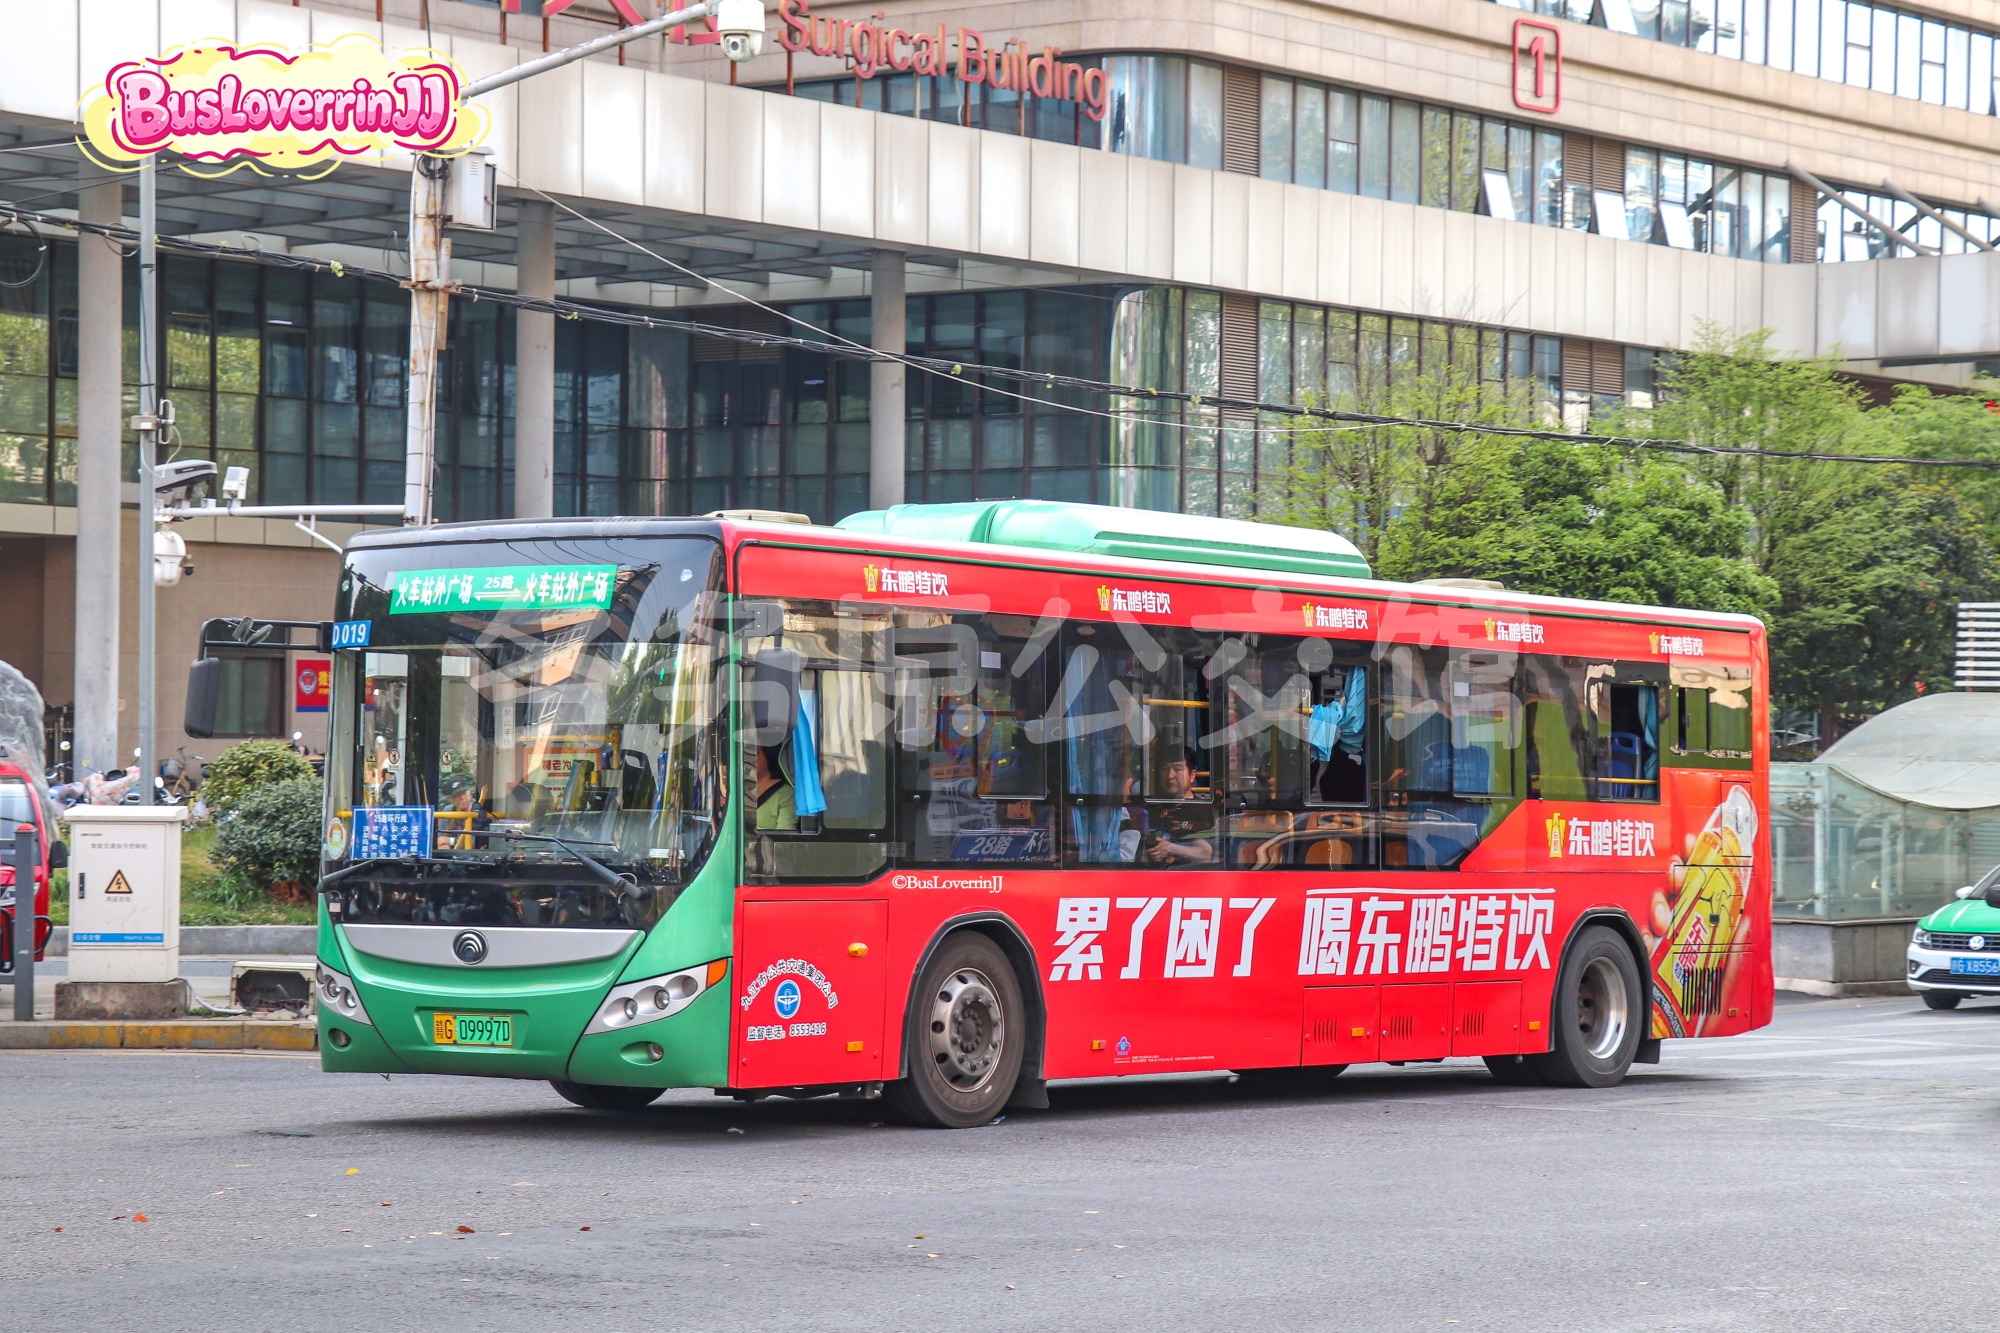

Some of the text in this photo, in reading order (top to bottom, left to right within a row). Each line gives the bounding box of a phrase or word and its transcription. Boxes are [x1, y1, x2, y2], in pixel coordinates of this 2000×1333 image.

[778, 0, 947, 80] Surgical
[956, 27, 1108, 121] Building
[1528, 35, 1545, 98] 1
[395, 570, 611, 608] 火车站外广场 25路 火车站外广场
[880, 566, 949, 597] 东鹏特饮
[1112, 586, 1172, 615] 东鹏特饮
[1315, 603, 1369, 630] 东鹏特饮
[1496, 619, 1545, 644] 东鹏特饮
[1659, 634, 1704, 657] 东鹏特饮
[968, 835, 1014, 855] 28路
[1568, 817, 1656, 857] 东鹏特饮
[1049, 893, 1556, 981] 累了困了 喝东鹏特饮
